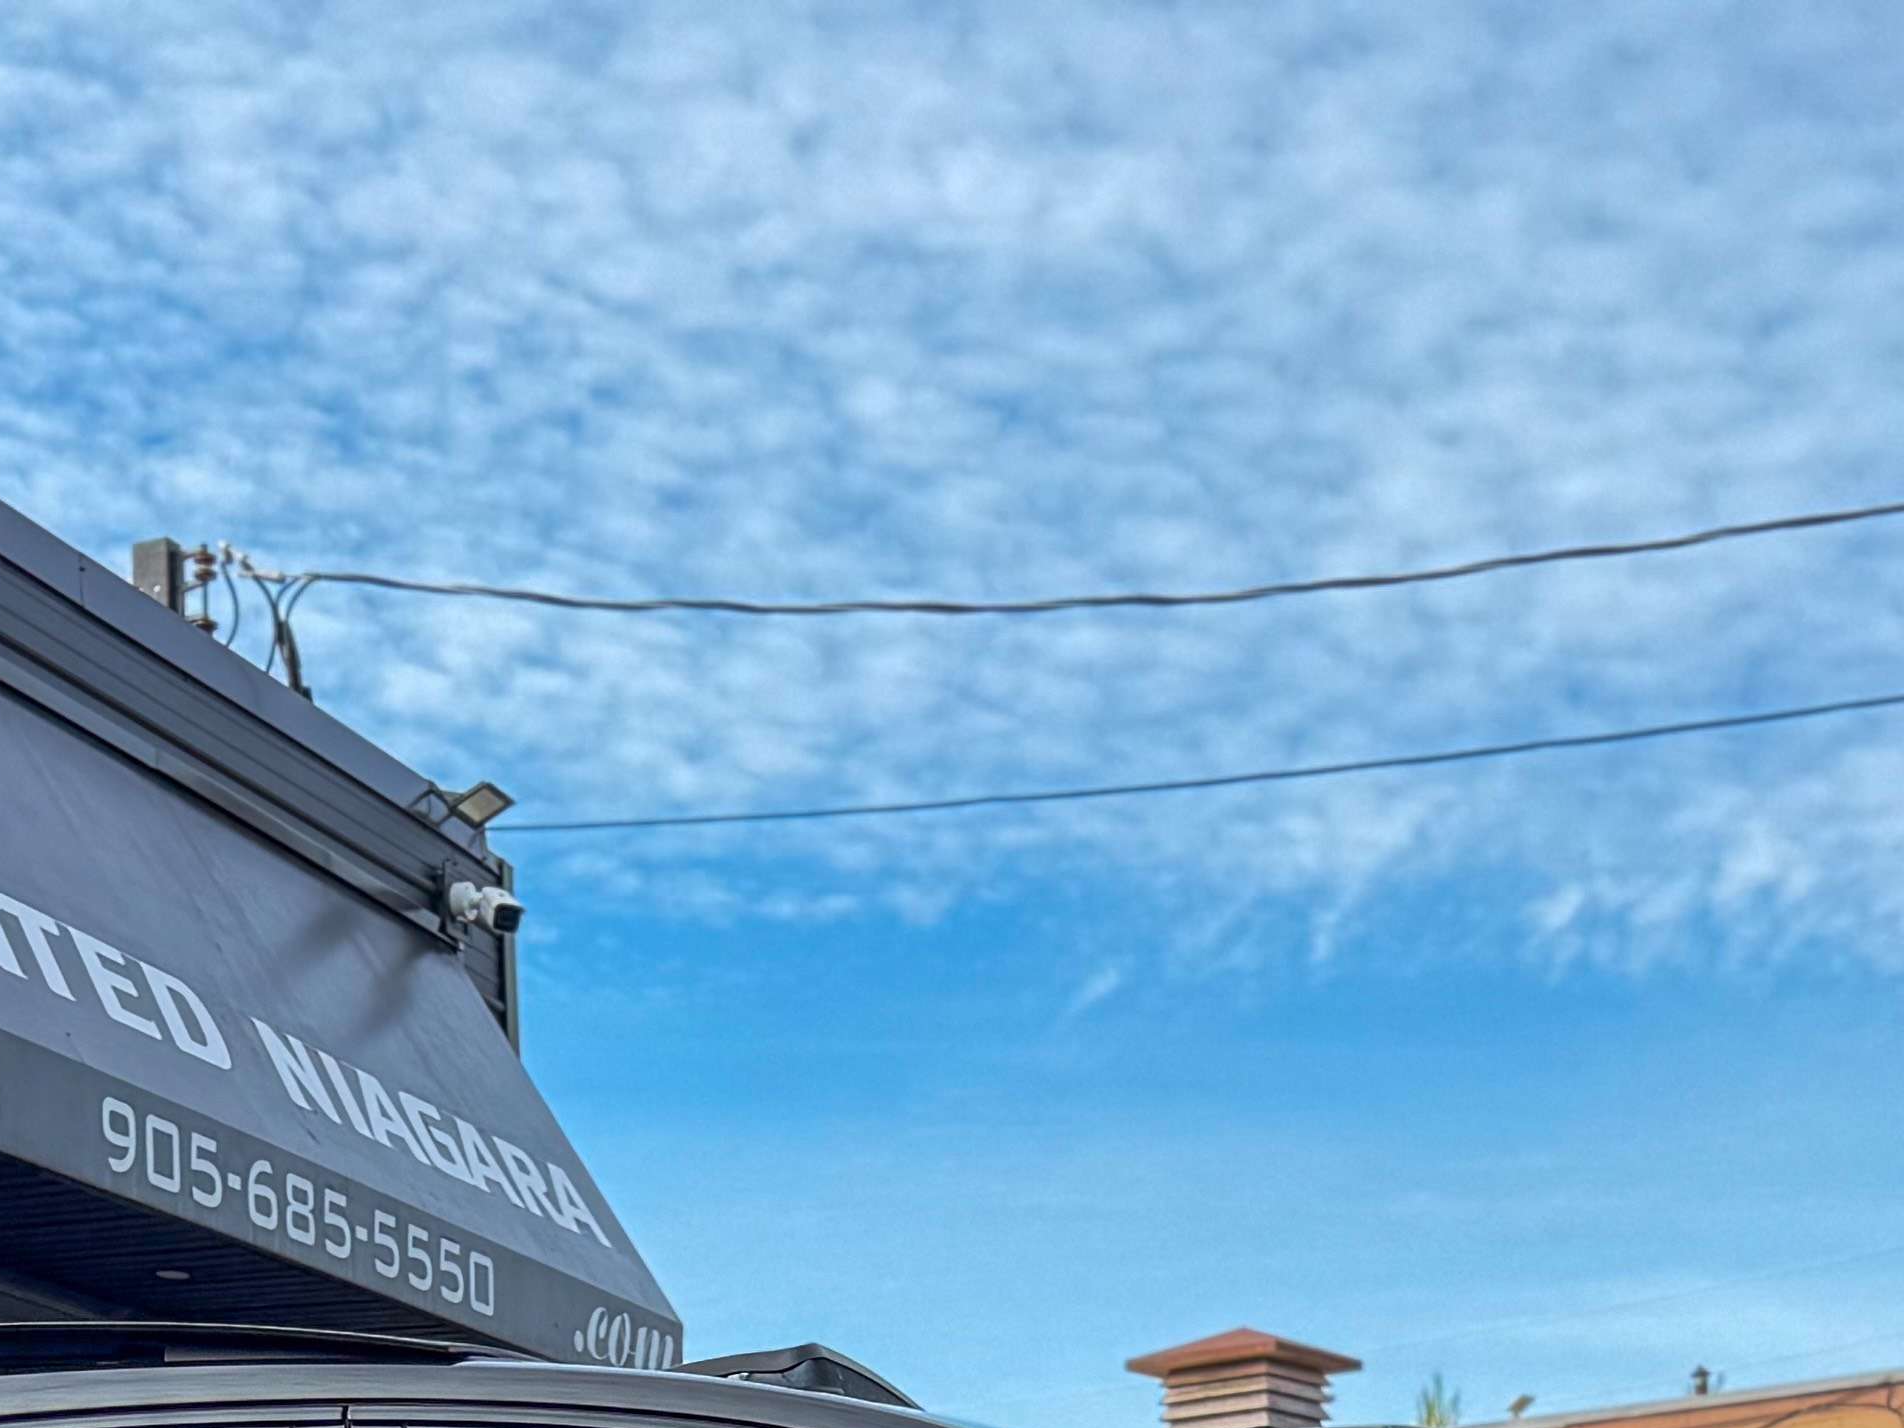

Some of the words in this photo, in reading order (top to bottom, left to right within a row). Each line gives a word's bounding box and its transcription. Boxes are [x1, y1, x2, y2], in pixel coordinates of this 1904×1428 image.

[102, 1096, 494, 1317] 905-685-5550
[250, 1016, 612, 1248] NIAGARA
[574, 1307, 673, 1369] .com
